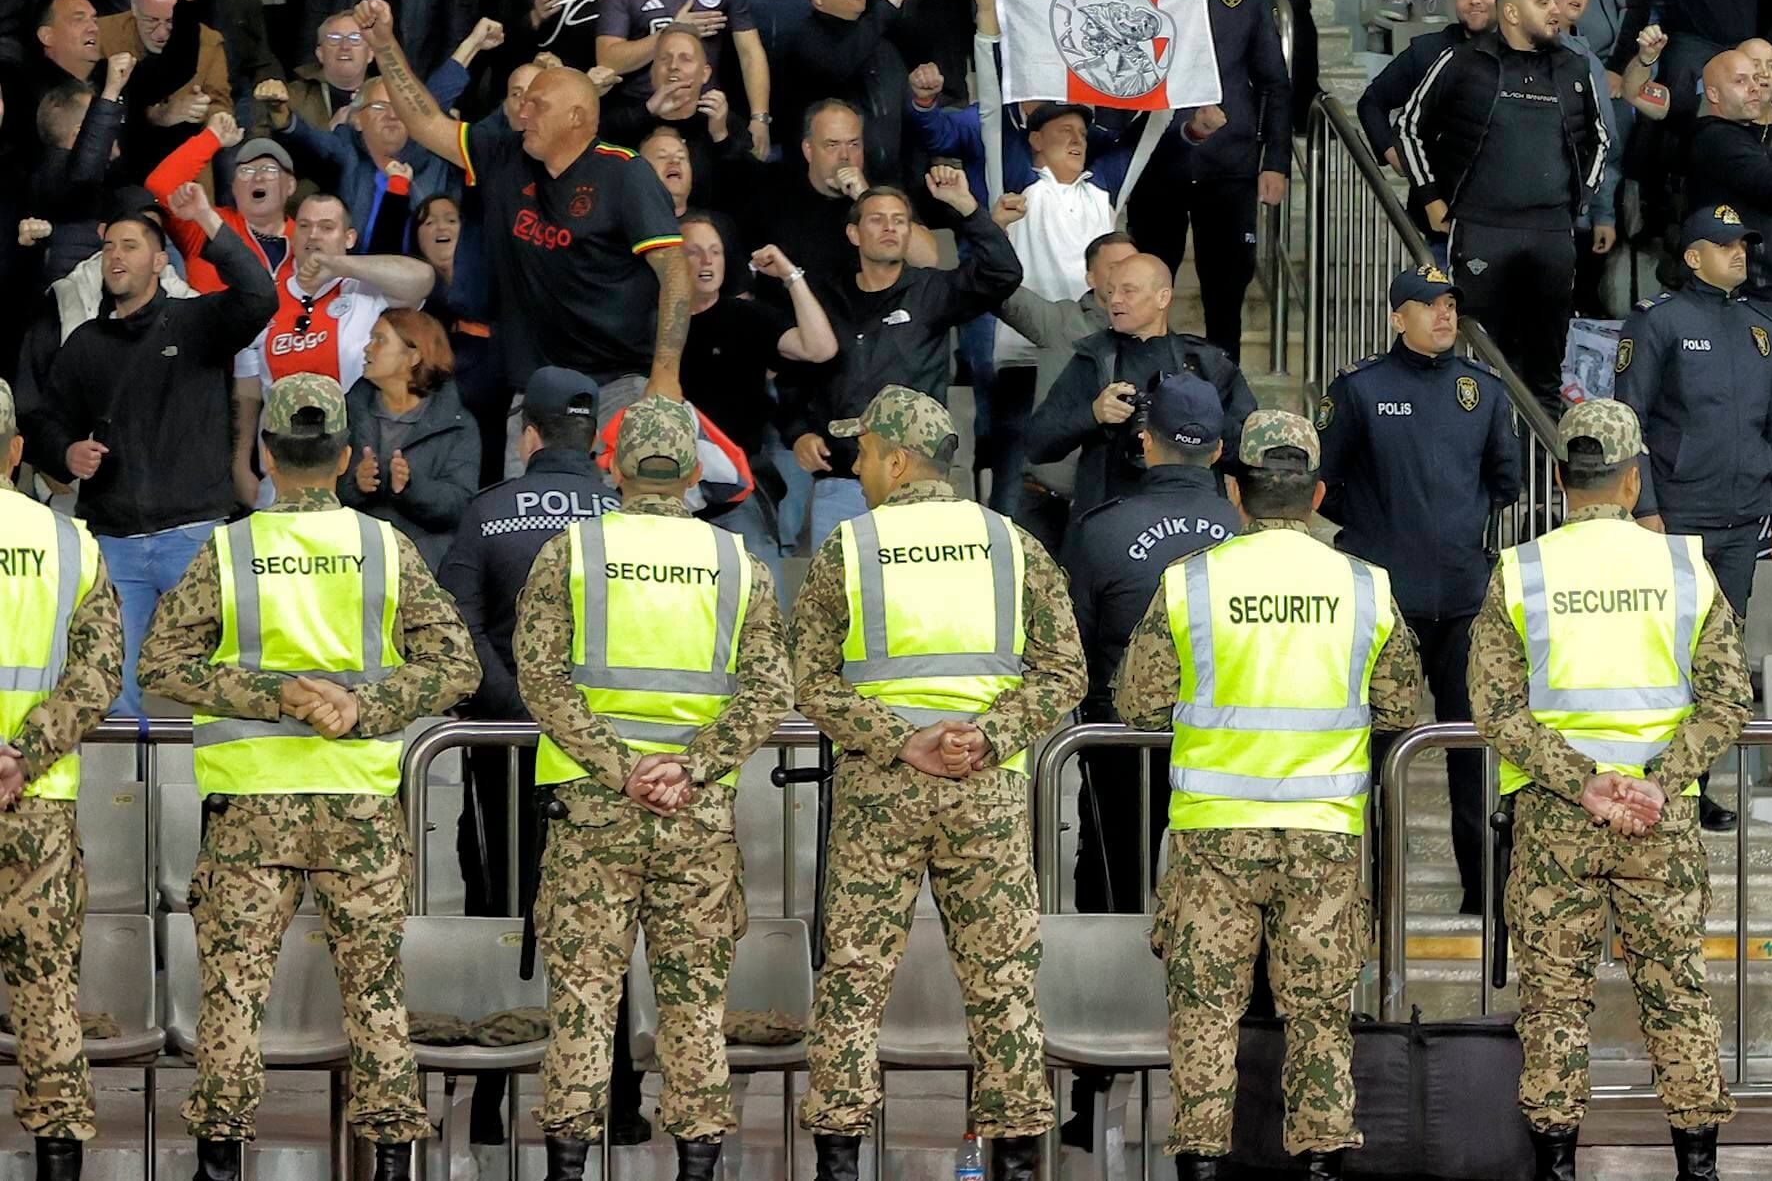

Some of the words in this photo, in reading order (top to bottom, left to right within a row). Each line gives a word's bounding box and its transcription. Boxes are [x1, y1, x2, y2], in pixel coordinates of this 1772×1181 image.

[0, 548, 46, 577] RITY
[252, 555, 367, 578] SECURITY
[878, 543, 992, 565] SECURITY
[604, 560, 721, 587] SECURITY
[1228, 596, 1340, 625] SECURITY
[1551, 588, 1665, 615] SECURITY
